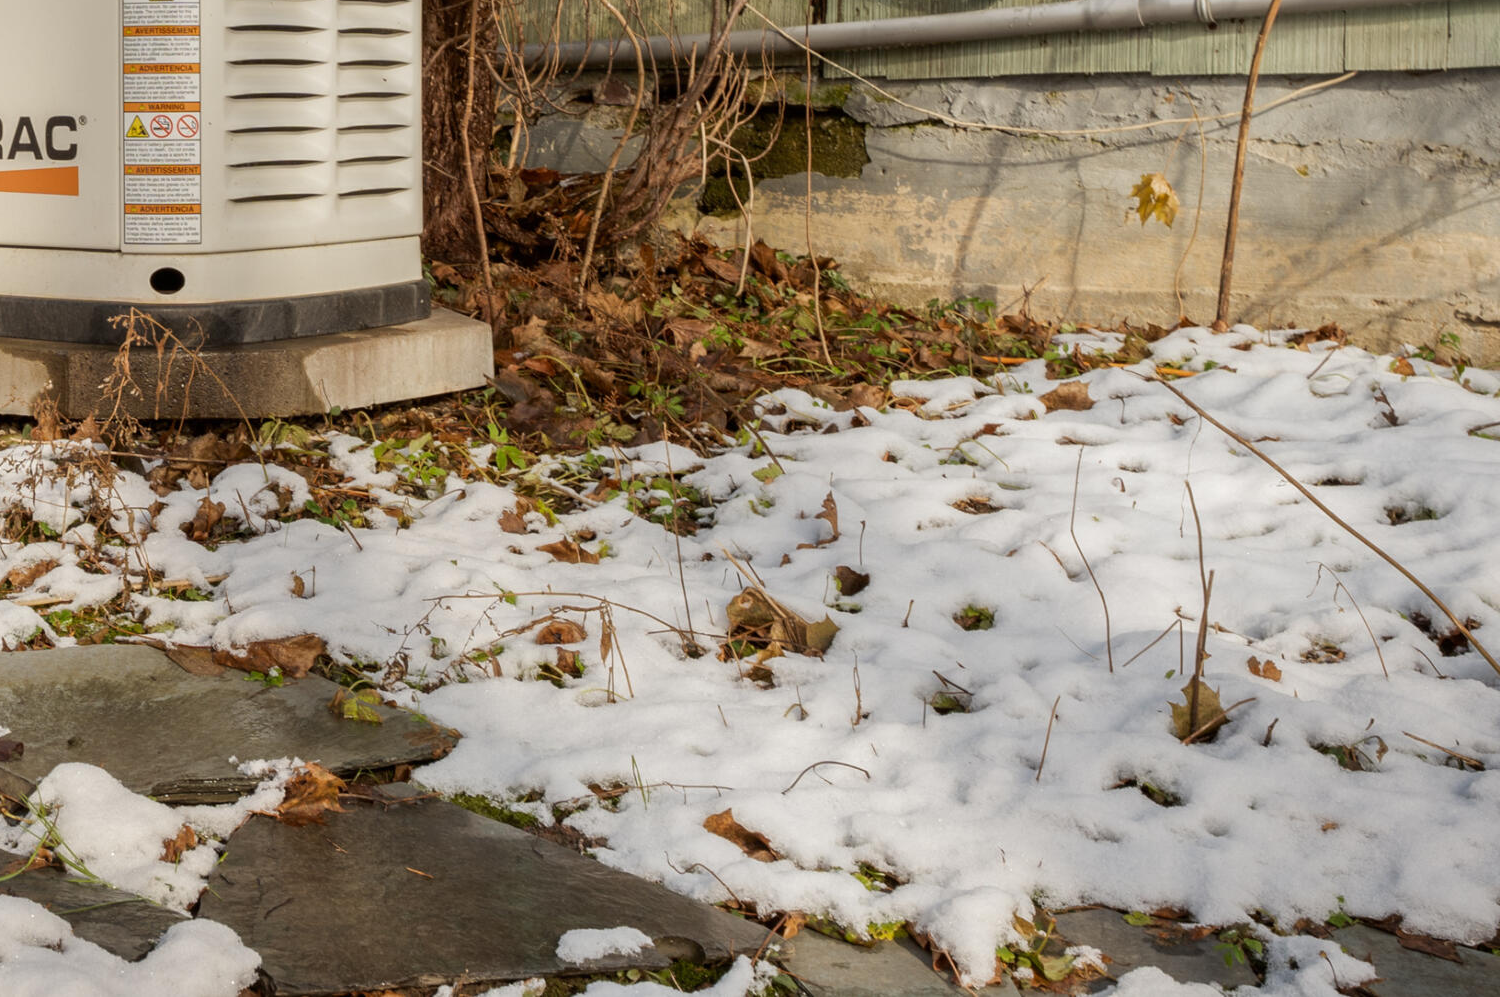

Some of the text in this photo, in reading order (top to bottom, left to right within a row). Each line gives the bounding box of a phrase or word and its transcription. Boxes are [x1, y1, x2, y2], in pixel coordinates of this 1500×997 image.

[135, 27, 198, 35] AVERTISSEMENT
[139, 64, 194, 72] ADVERTENCIA
[148, 103, 185, 111] WARNING
[136, 166, 199, 174] AVERTISSEMENT
[140, 205, 195, 213] ADVERTENCIA
